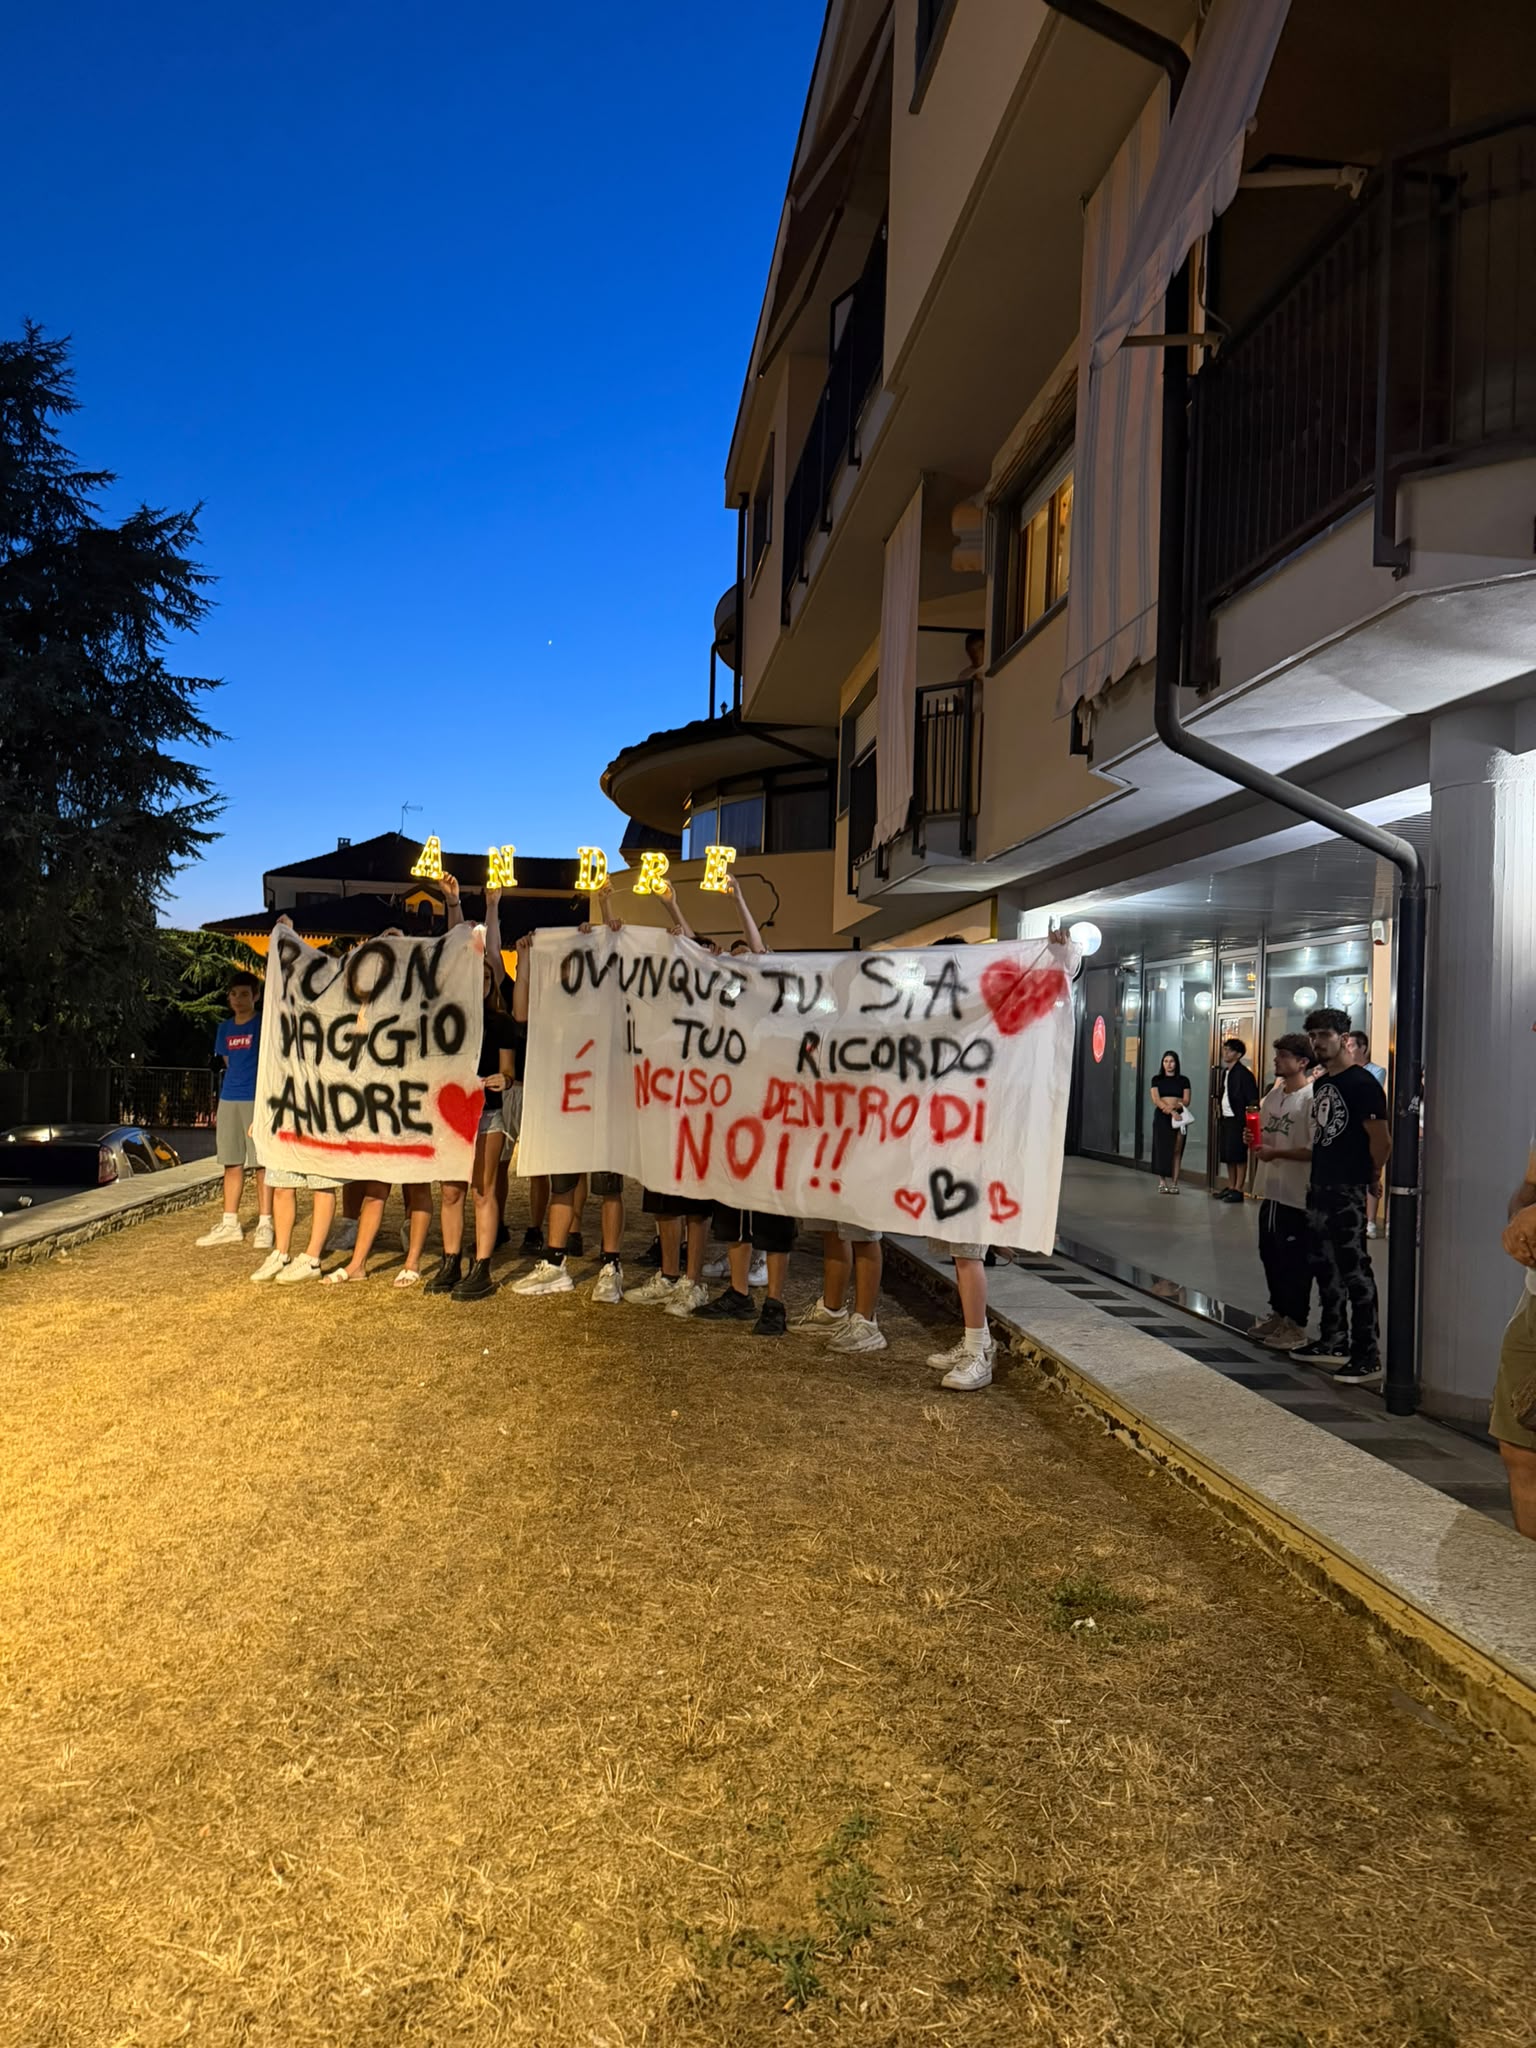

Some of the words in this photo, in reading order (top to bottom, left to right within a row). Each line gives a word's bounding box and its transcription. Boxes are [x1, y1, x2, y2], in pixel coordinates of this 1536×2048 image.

[560, 947, 748, 1008] OVUNQUE
[761, 969, 824, 1014] TU
[672, 1018, 748, 1066] TUO
[796, 1030, 996, 1082] RICORDO
[266, 1076, 434, 1138] ANDRE
[761, 1076, 921, 1144] DENTRO
